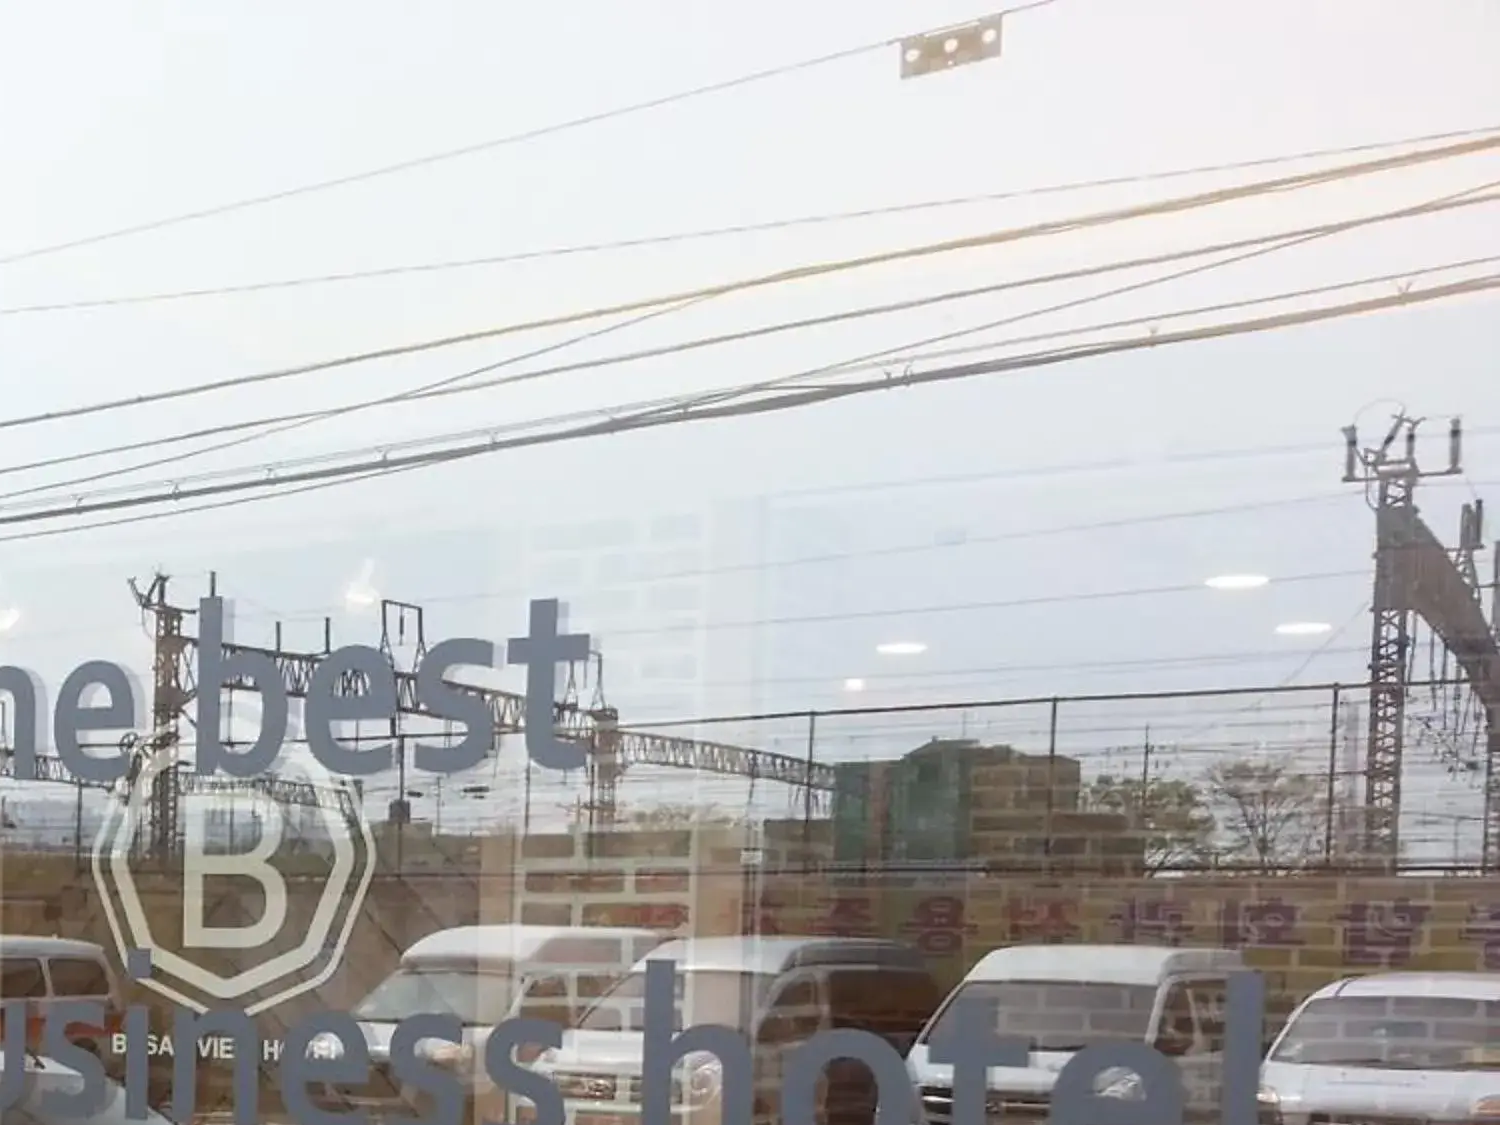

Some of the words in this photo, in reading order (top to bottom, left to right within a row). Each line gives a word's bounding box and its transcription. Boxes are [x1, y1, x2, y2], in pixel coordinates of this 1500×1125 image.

[196, 596, 591, 776] best
[183, 794, 287, 948] B
[111, 1032, 176, 1057] BSA
[197, 1037, 236, 1060] VIE
